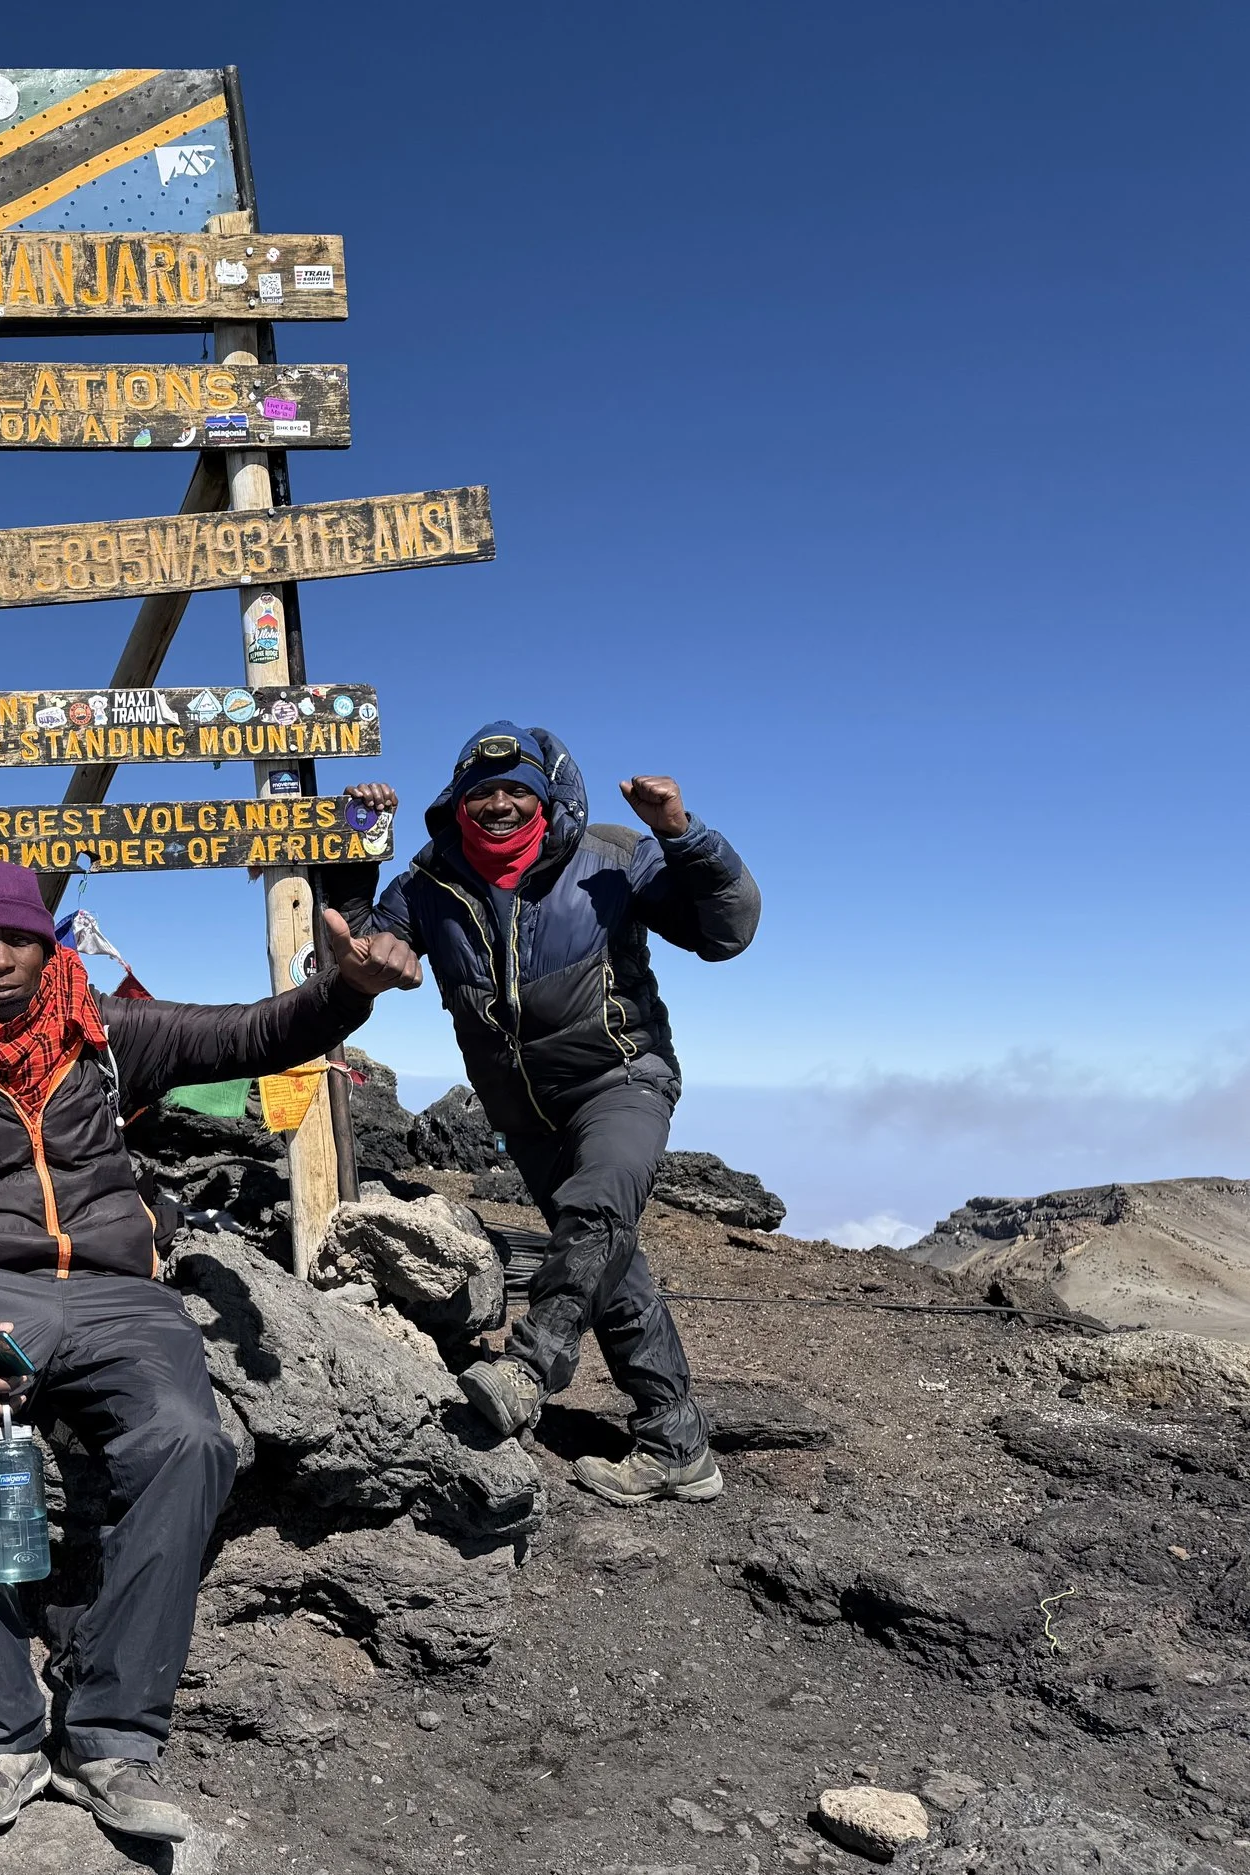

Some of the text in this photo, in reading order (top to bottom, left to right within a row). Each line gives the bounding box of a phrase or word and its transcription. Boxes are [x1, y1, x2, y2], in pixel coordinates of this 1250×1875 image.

[83, 414, 125, 443] AT
[208, 429, 247, 438] patagonia
[374, 500, 479, 562] AMSL
[114, 691, 149, 708] MAXI
[112, 706, 155, 724] TRANQI
[199, 722, 360, 755] MOUNTAIN
[123, 801, 336, 835] VOLCANOES
[187, 836, 230, 864] OF
[249, 832, 367, 862] AFRICA
